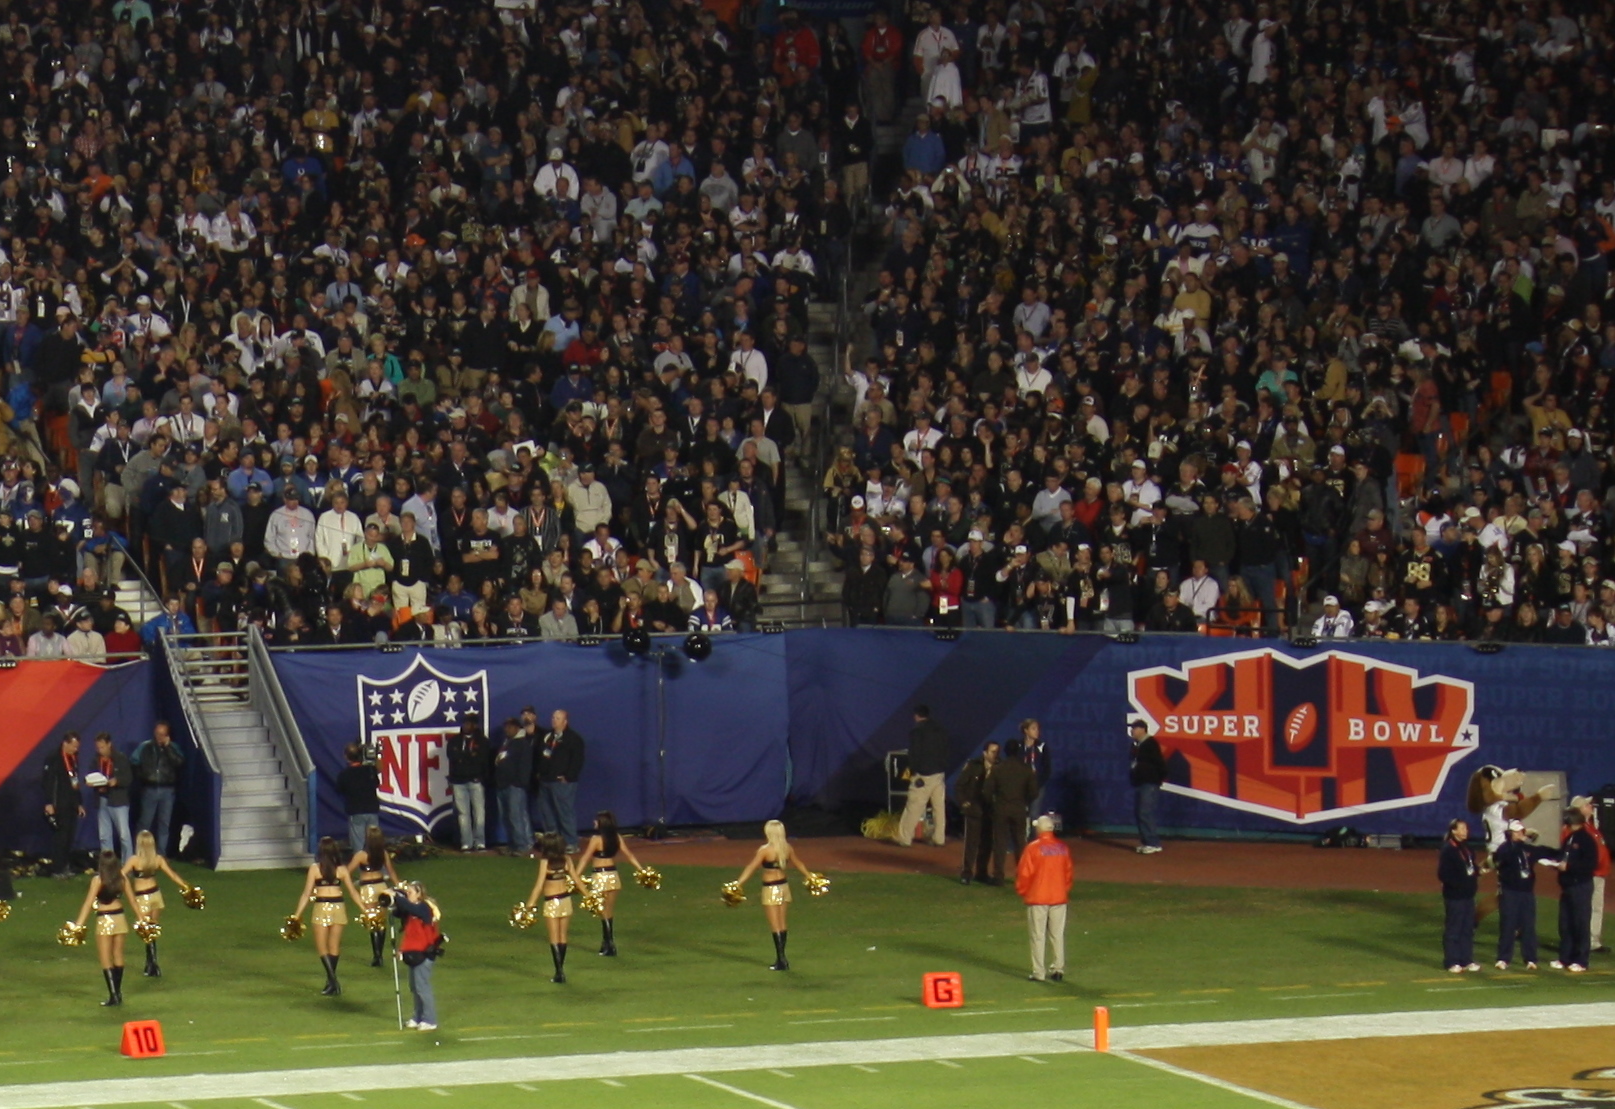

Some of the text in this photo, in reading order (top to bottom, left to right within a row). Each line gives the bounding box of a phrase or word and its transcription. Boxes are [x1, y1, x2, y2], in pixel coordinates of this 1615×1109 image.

[1163, 714, 1444, 742] SUPER BOWL
[376, 733, 454, 805] NF
[932, 977, 954, 1003] G
[133, 1026, 158, 1053] 10
